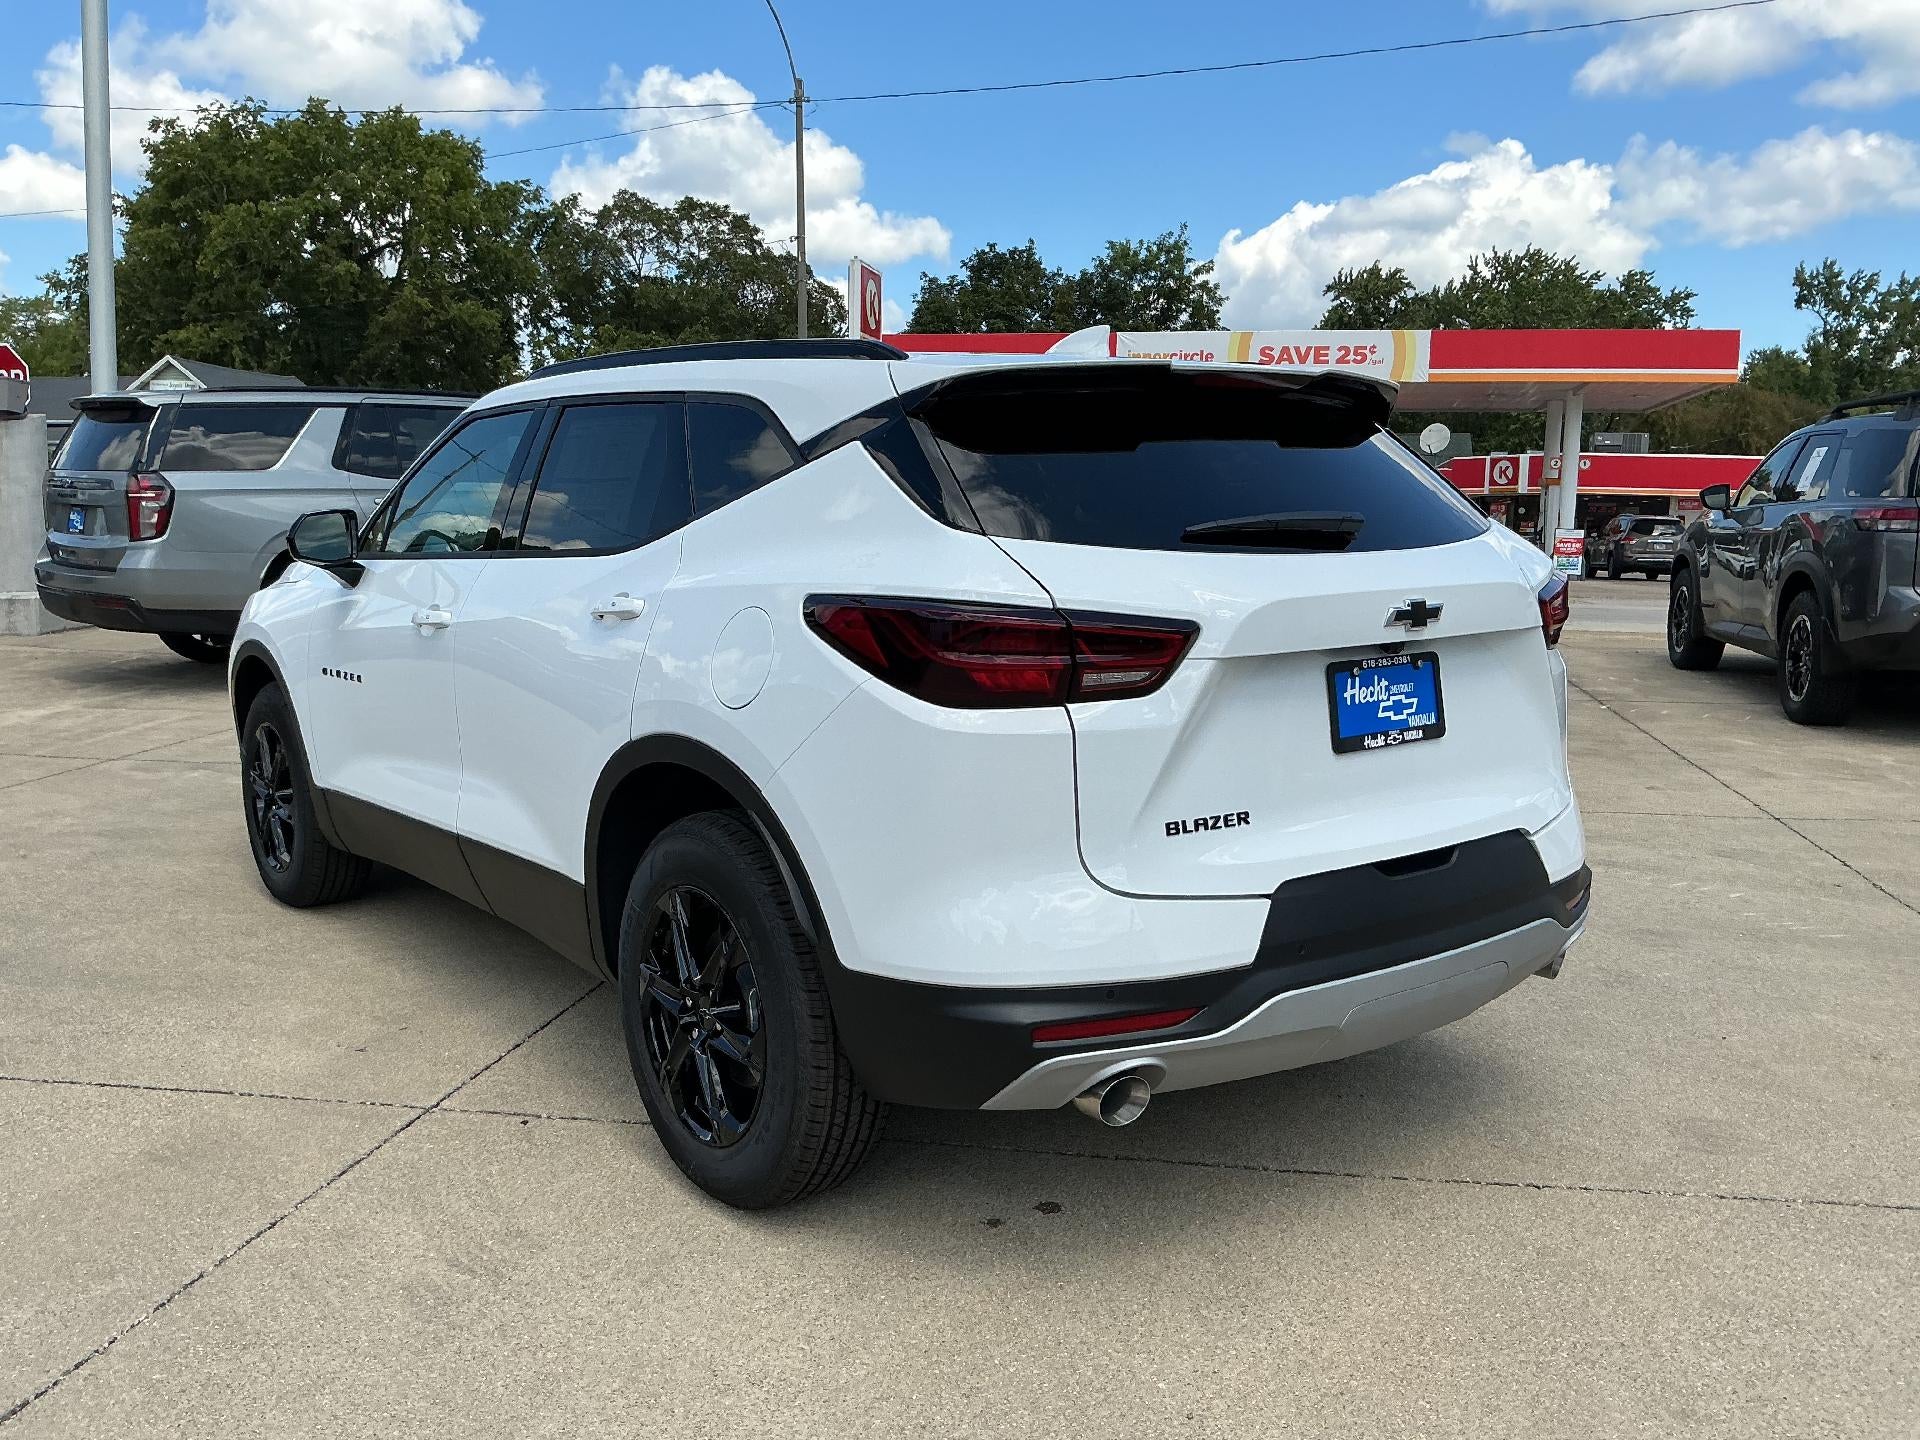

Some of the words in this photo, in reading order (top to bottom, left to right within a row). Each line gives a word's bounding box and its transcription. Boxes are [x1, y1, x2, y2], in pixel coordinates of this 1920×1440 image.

[1258, 345, 1331, 366] SAVE
[322, 667, 362, 684] BLAZER
[1343, 674, 1389, 706] Hecht
[1363, 734, 1386, 749] Hecht
[1164, 810, 1251, 837] BLAZER
